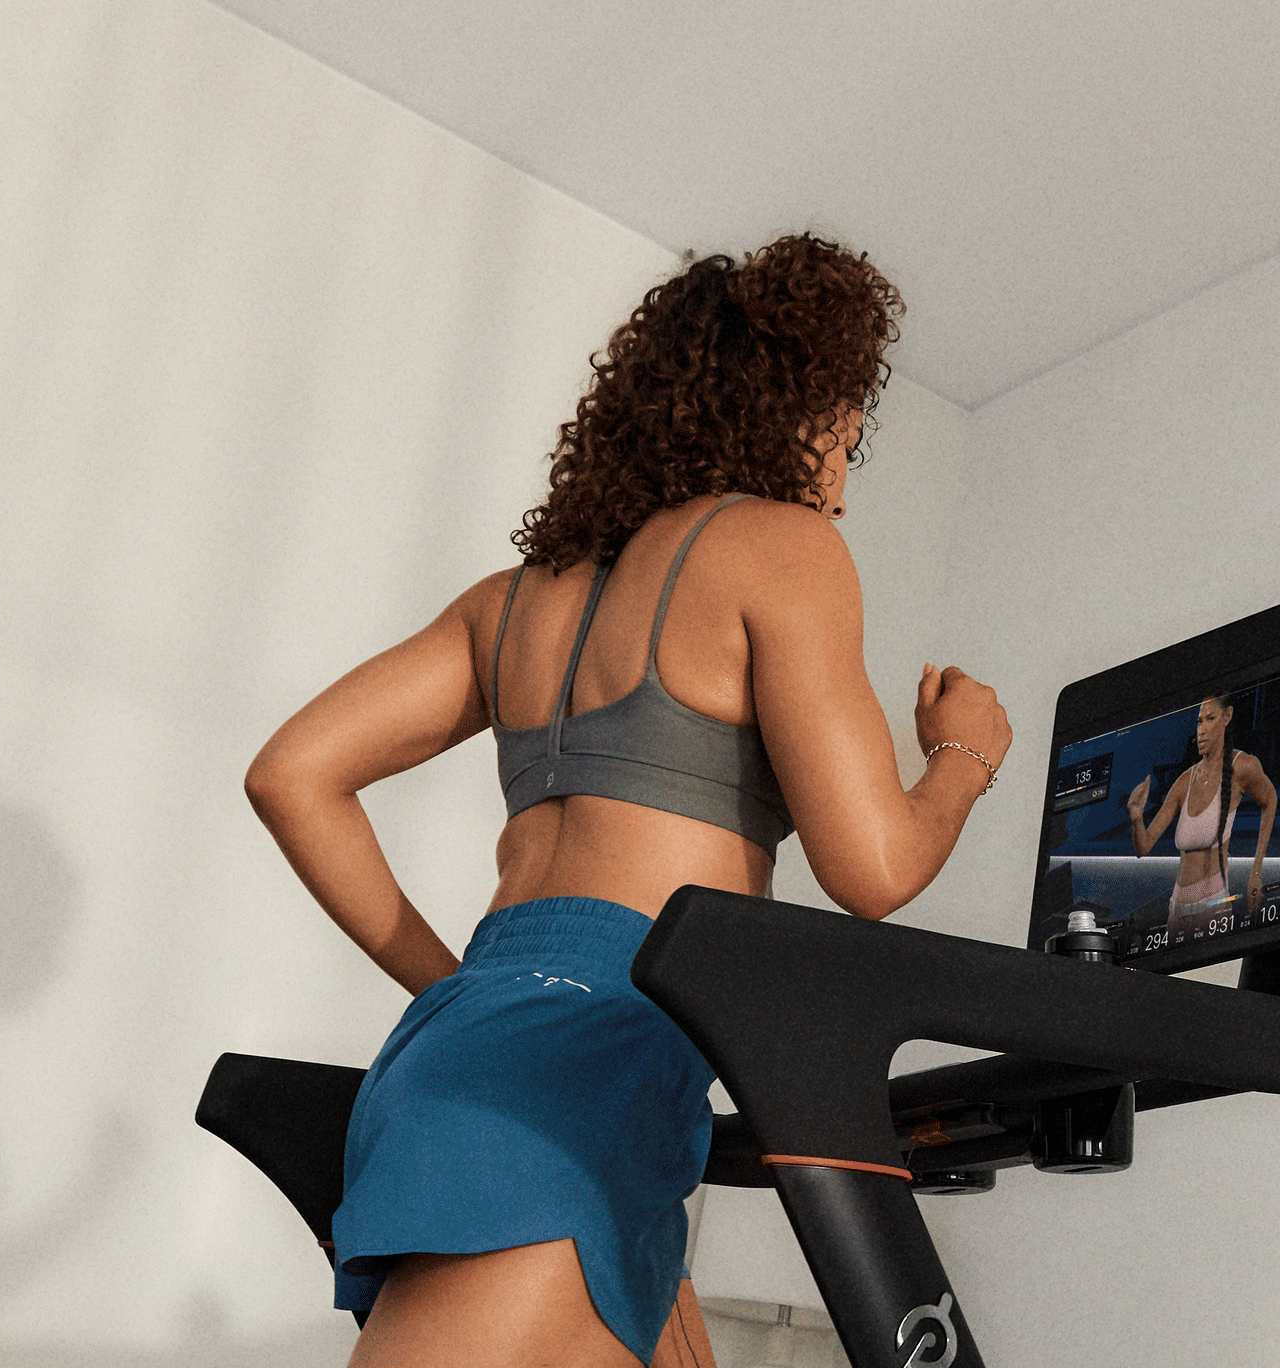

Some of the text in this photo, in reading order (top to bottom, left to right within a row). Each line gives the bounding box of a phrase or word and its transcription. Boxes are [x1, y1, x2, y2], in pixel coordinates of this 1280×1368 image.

[1075, 769, 1092, 784] 135
[1208, 915, 1235, 936] 9:31
[1144, 931, 1169, 951] 294
